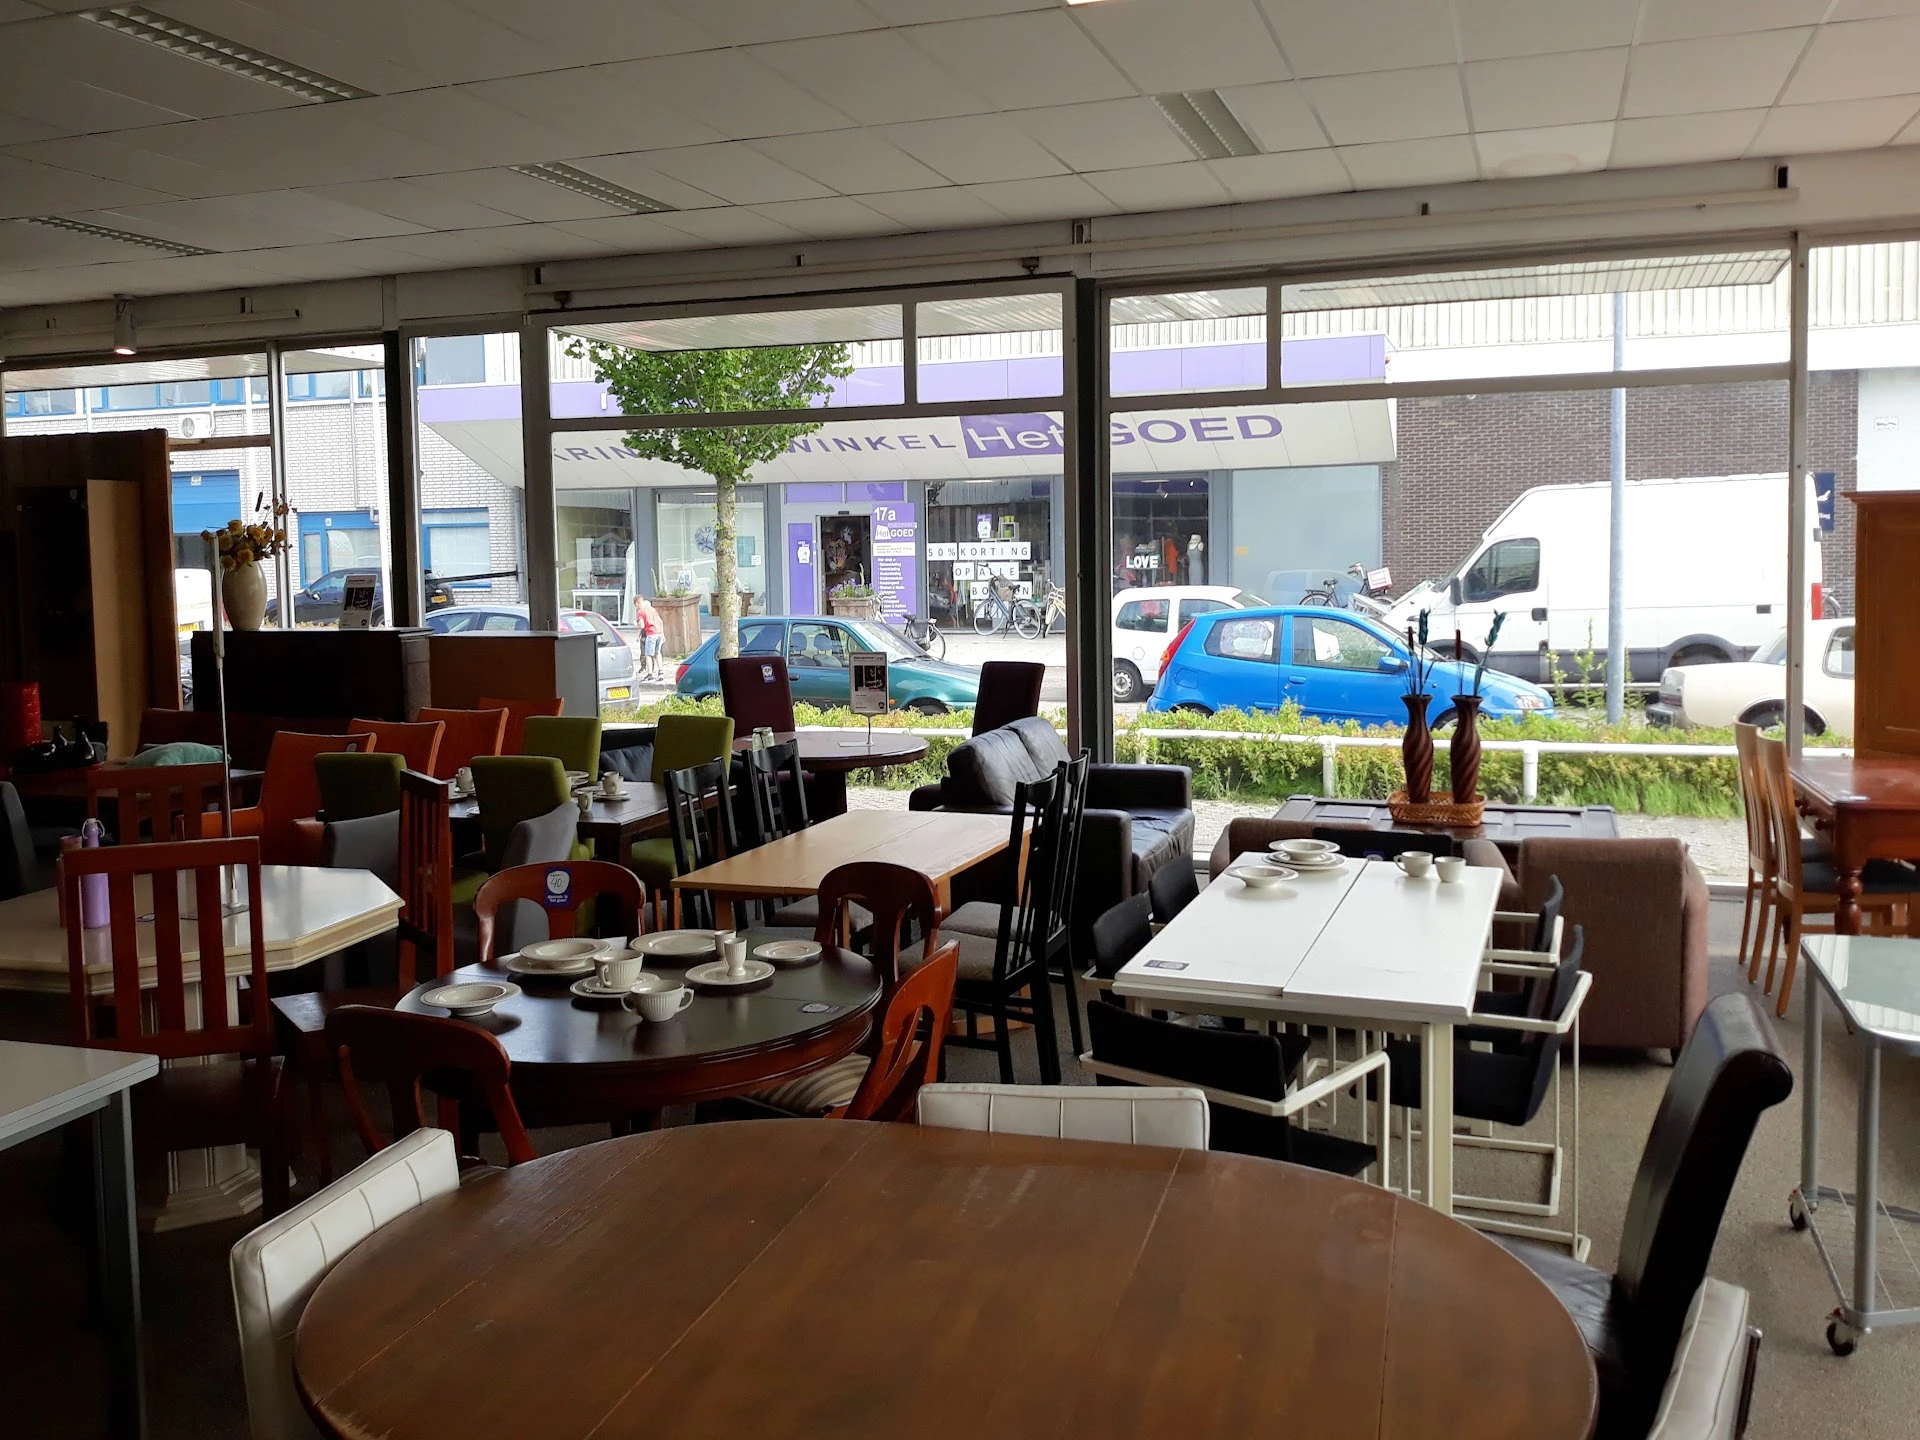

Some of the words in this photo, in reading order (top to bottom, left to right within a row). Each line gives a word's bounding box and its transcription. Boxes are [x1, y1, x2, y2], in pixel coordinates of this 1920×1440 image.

[967, 425, 1064, 451] Het
[873, 506, 897, 521] 17a
[890, 529, 914, 538] GOED
[928, 548, 956, 556] 50%
[960, 547, 1028, 556] KORTING
[1126, 555, 1159, 568] LOVE
[955, 567, 971, 576] OP
[979, 567, 1015, 576] ALLE
[972, 587, 1029, 595] BON
